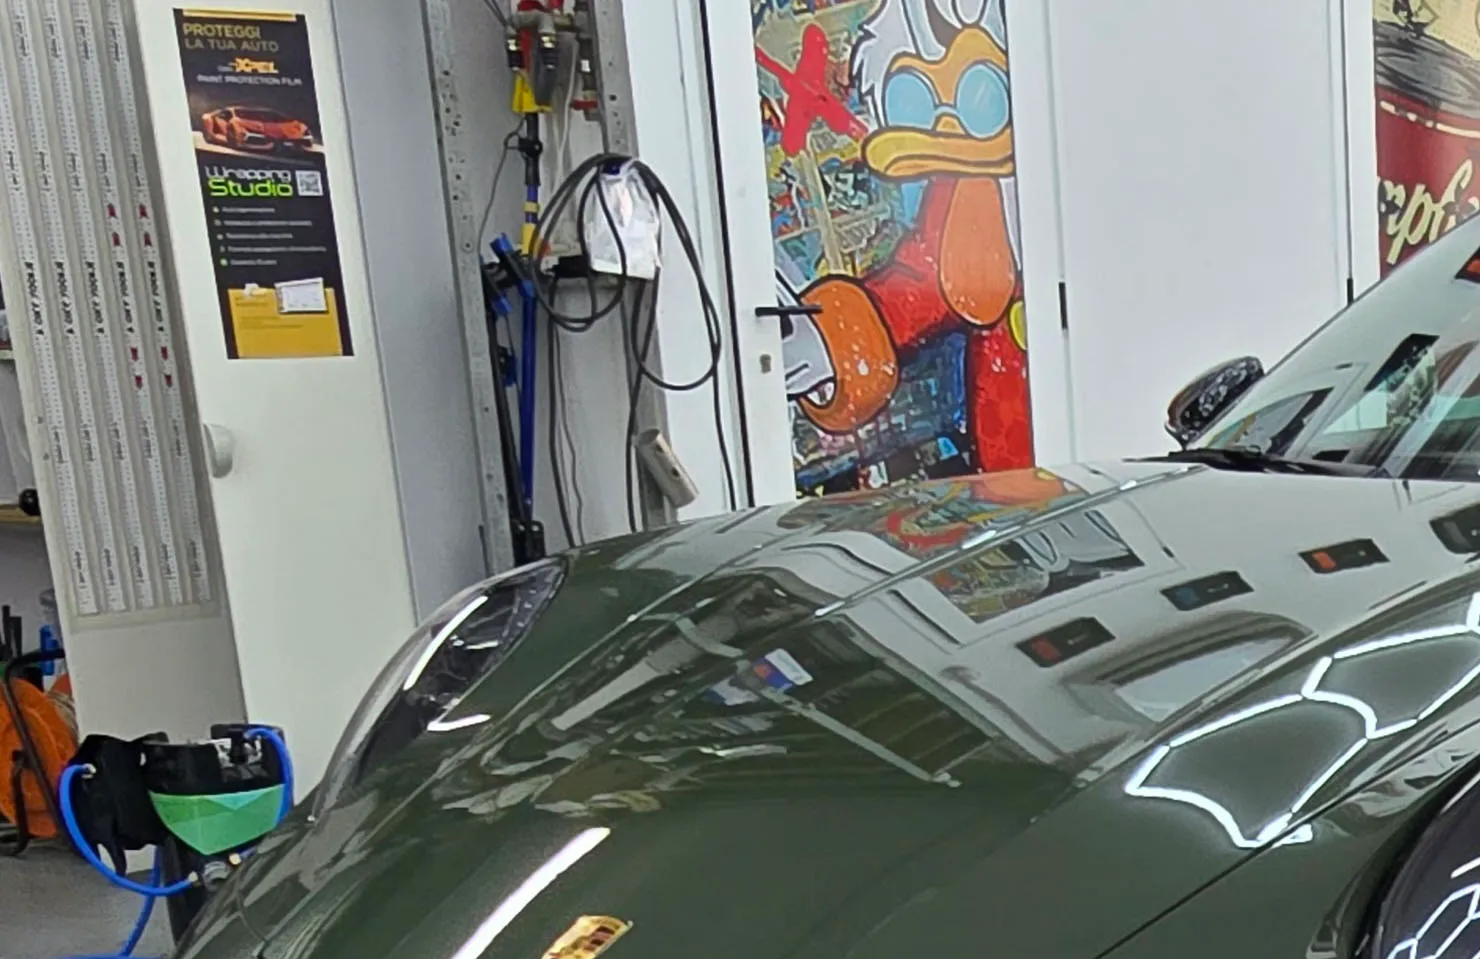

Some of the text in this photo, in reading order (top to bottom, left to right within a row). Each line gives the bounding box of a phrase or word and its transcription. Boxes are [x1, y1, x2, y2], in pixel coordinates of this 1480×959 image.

[183, 23, 261, 39] PROTEGGI
[185, 38, 279, 53] LA TUA AUTO
[207, 177, 294, 197] Studio
